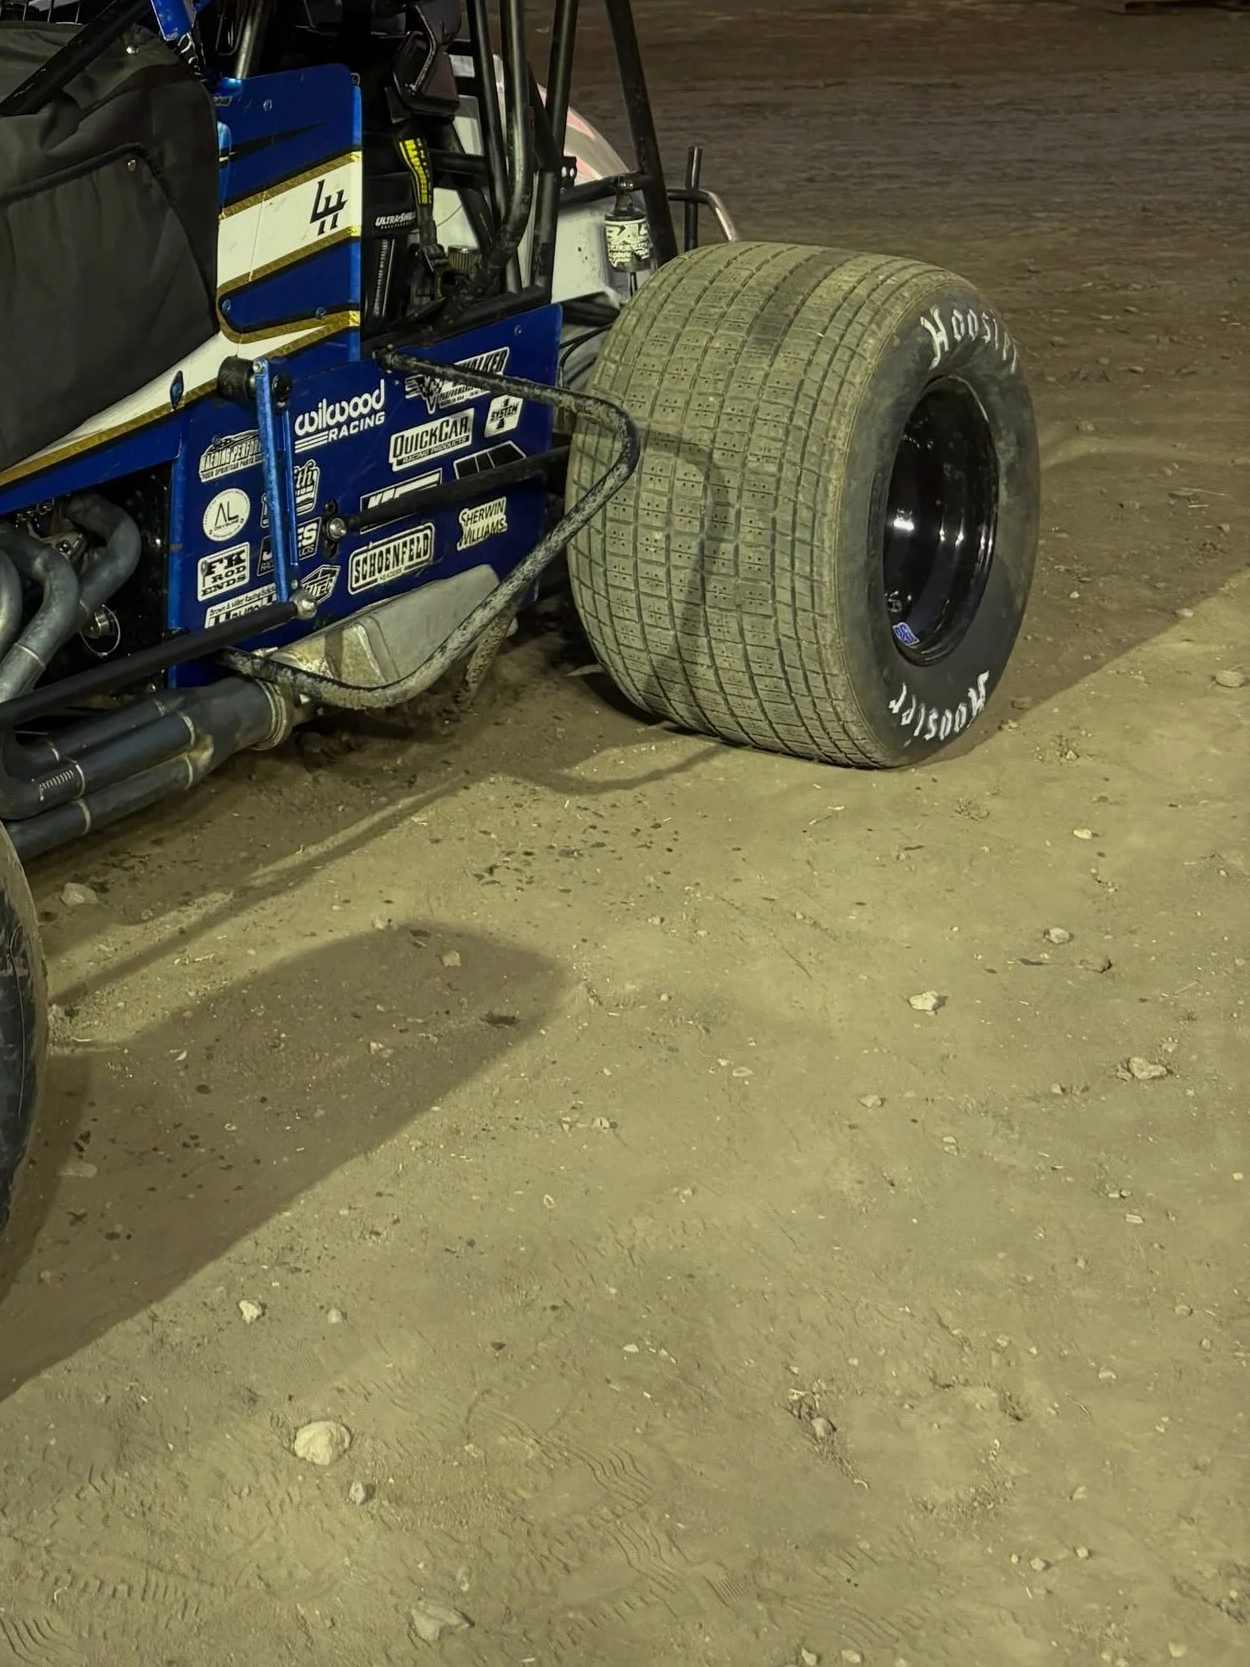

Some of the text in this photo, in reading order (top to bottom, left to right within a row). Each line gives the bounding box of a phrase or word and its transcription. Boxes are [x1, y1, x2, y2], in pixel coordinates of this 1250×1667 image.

[294, 379, 385, 436] wilwood
[490, 403, 519, 422] SYSTEM
[328, 411, 385, 442] RACING
[461, 499, 506, 525] SHERWIN
[354, 533, 430, 584] SCHOENFELD
[201, 575, 246, 596] ENDS
[211, 565, 246, 583] ROD
